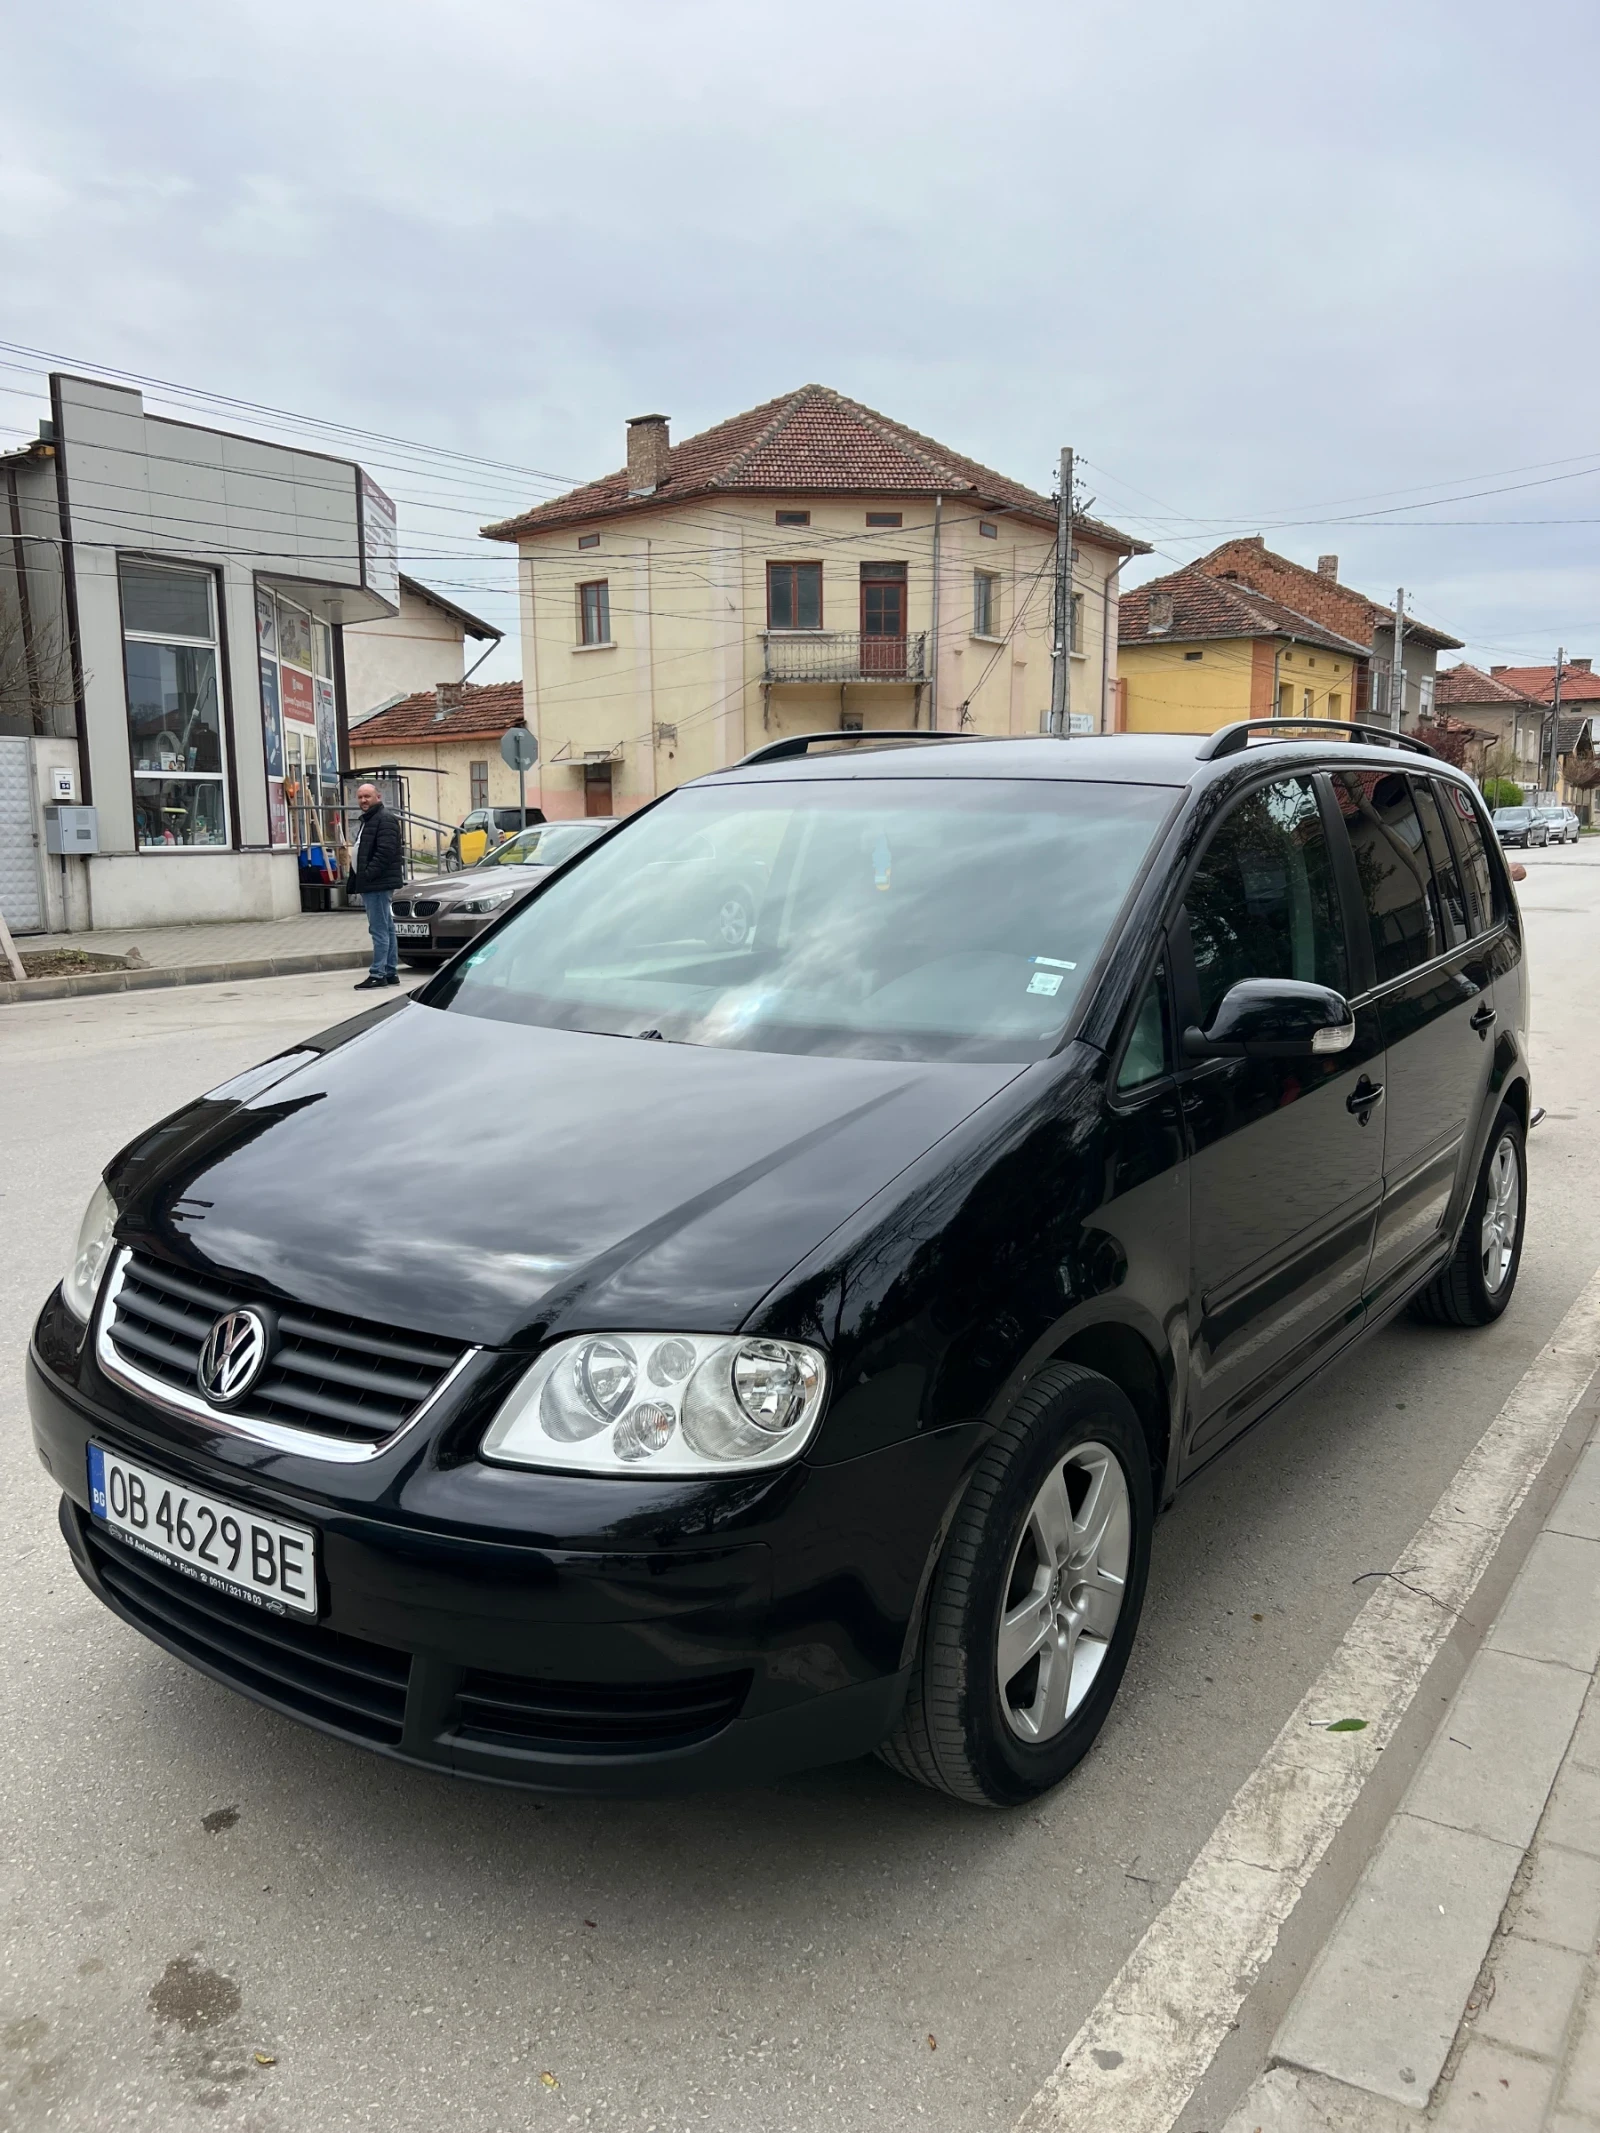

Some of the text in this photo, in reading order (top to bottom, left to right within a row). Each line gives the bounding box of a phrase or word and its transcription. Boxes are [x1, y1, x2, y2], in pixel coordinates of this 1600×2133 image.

[93, 1487, 106, 1508] BG
[109, 1466, 306, 1600] OB 4629 BE
[134, 1539, 172, 1567] Automobile
[179, 1562, 198, 1579] Fürth
[252, 1594, 262, 1606] 03
